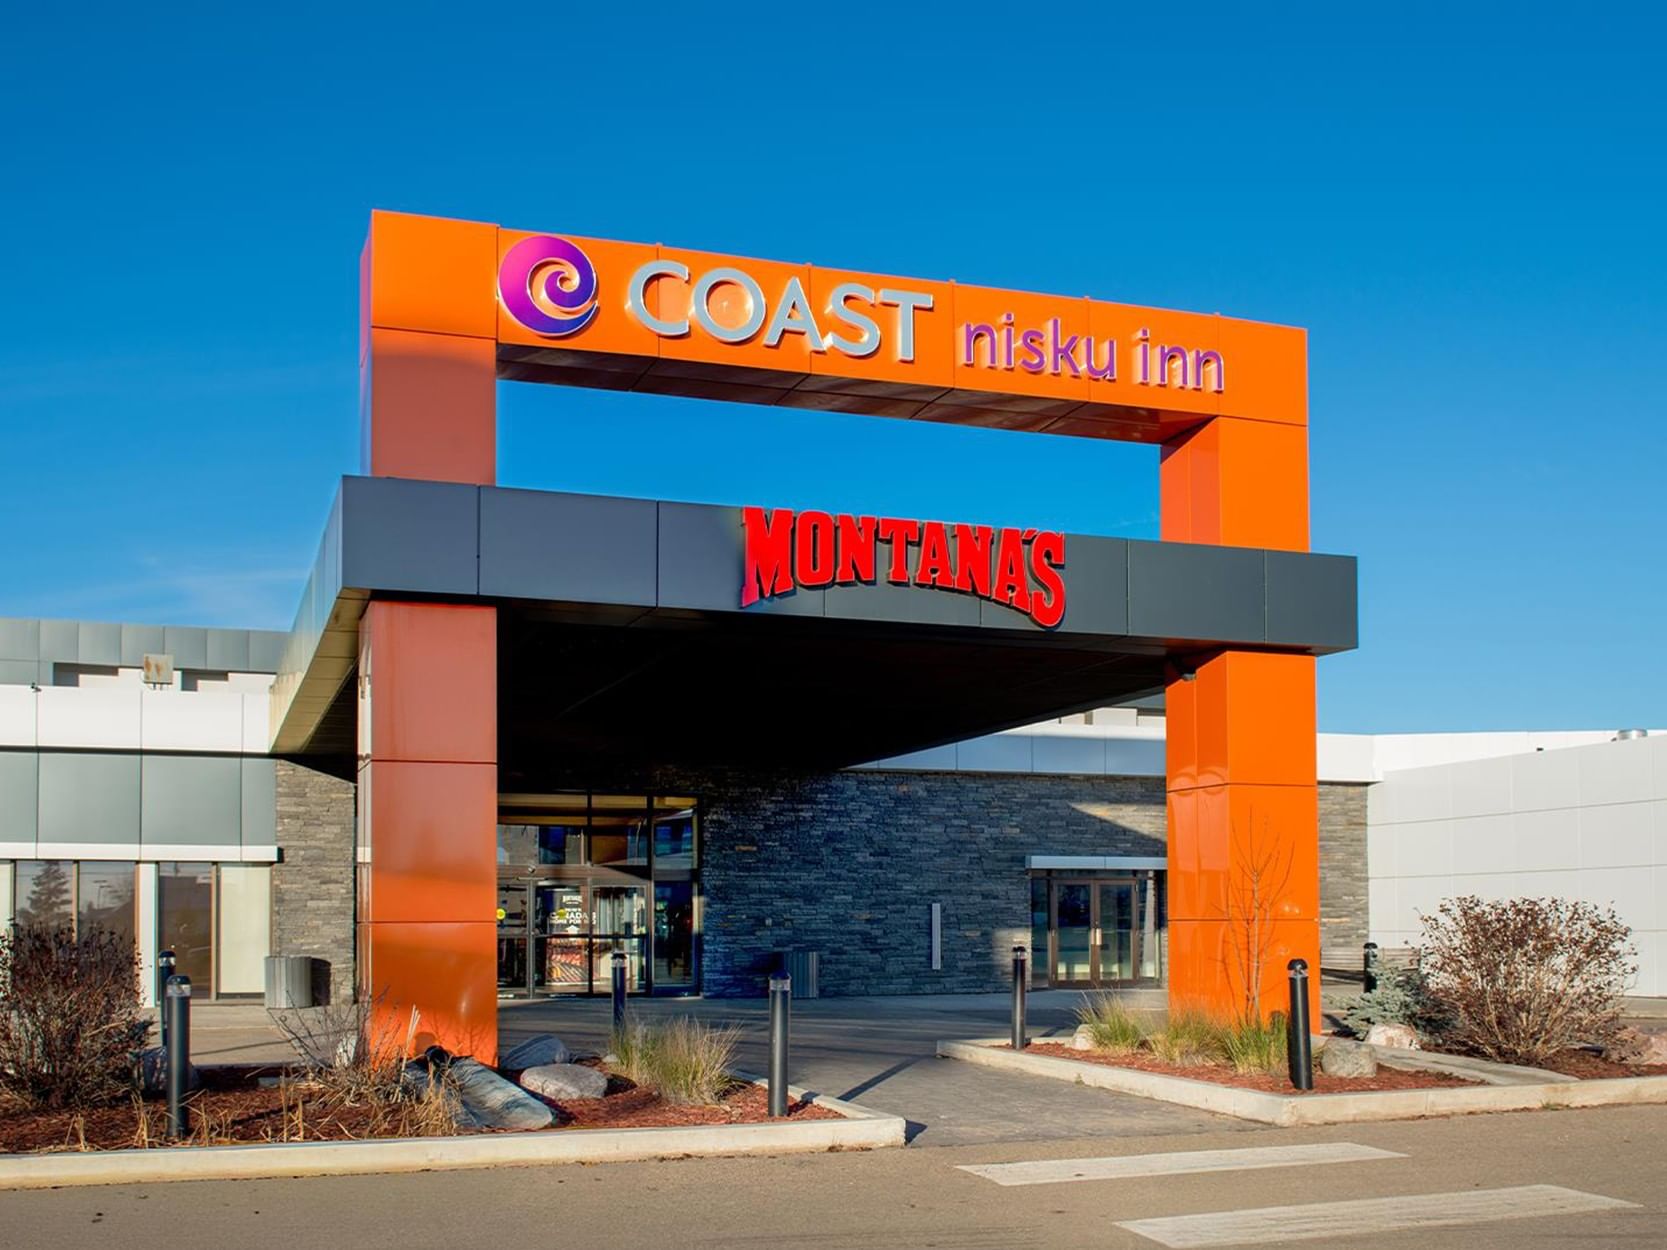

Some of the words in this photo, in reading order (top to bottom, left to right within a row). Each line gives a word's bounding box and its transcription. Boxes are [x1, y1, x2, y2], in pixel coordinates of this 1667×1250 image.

[628, 259, 934, 362] COAST
[962, 312, 1117, 380] nisku
[1139, 328, 1225, 391] inn
[741, 505, 1066, 628] MONTANA'S
